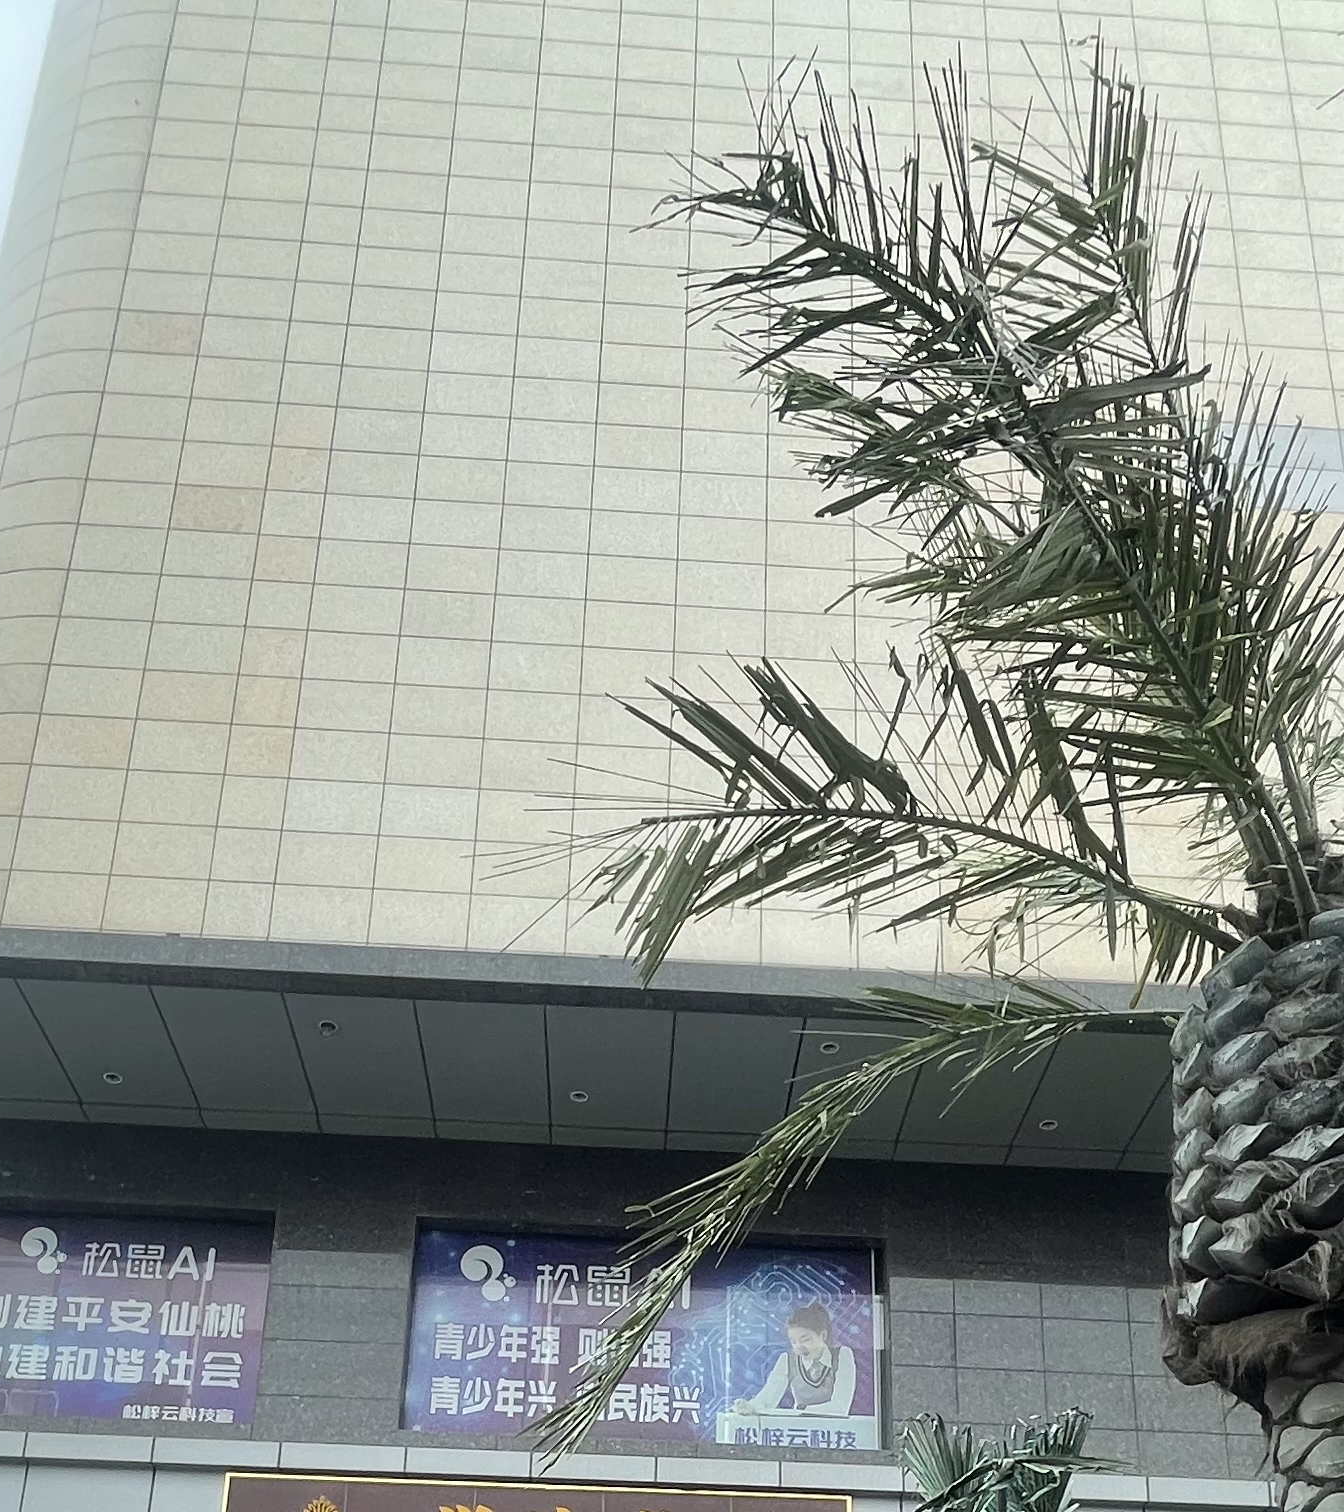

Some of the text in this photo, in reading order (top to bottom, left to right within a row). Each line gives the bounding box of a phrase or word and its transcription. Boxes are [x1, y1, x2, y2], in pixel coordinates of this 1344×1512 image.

[81, 1241, 218, 1281] 松鼠AI
[434, 1322, 561, 1365] 青少年强
[429, 1375, 557, 1419] 青少年兴
